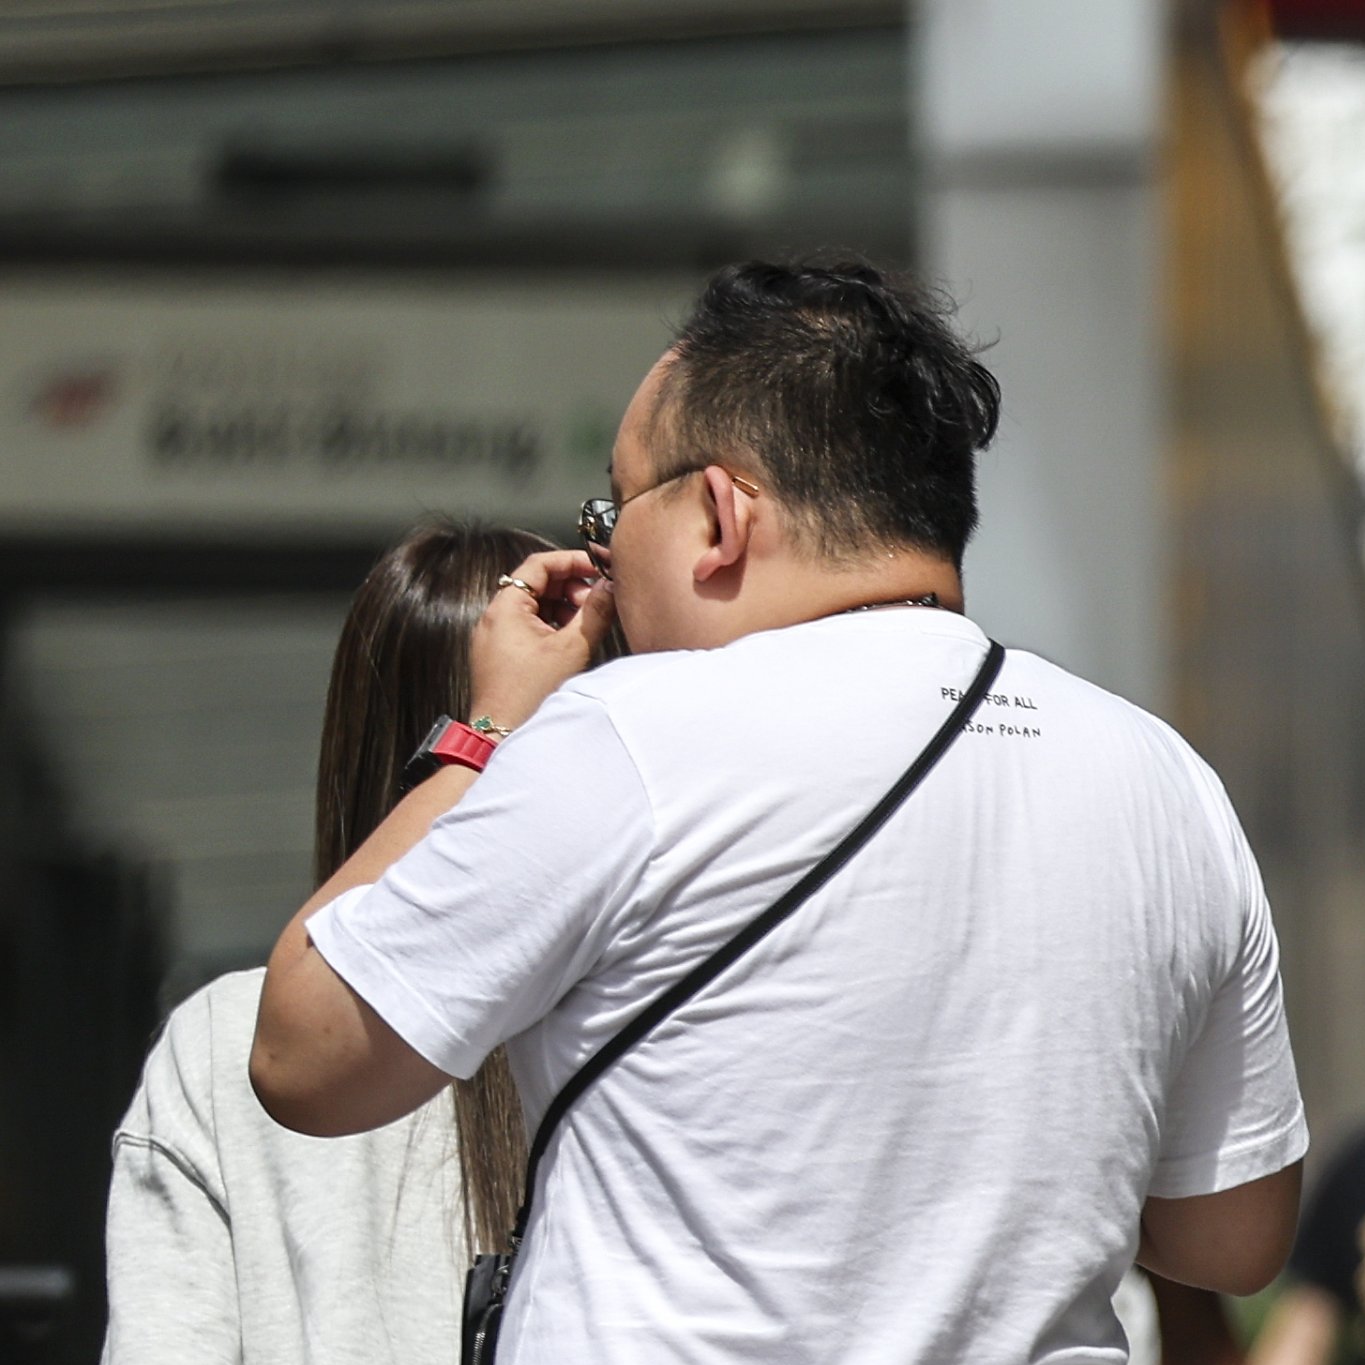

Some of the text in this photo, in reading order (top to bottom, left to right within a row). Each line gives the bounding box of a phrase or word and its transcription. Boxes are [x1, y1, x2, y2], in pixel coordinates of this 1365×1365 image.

[984, 692, 1010, 707] FOR
[1015, 696, 1038, 710] ALL
[999, 723, 1041, 738] POLAN
